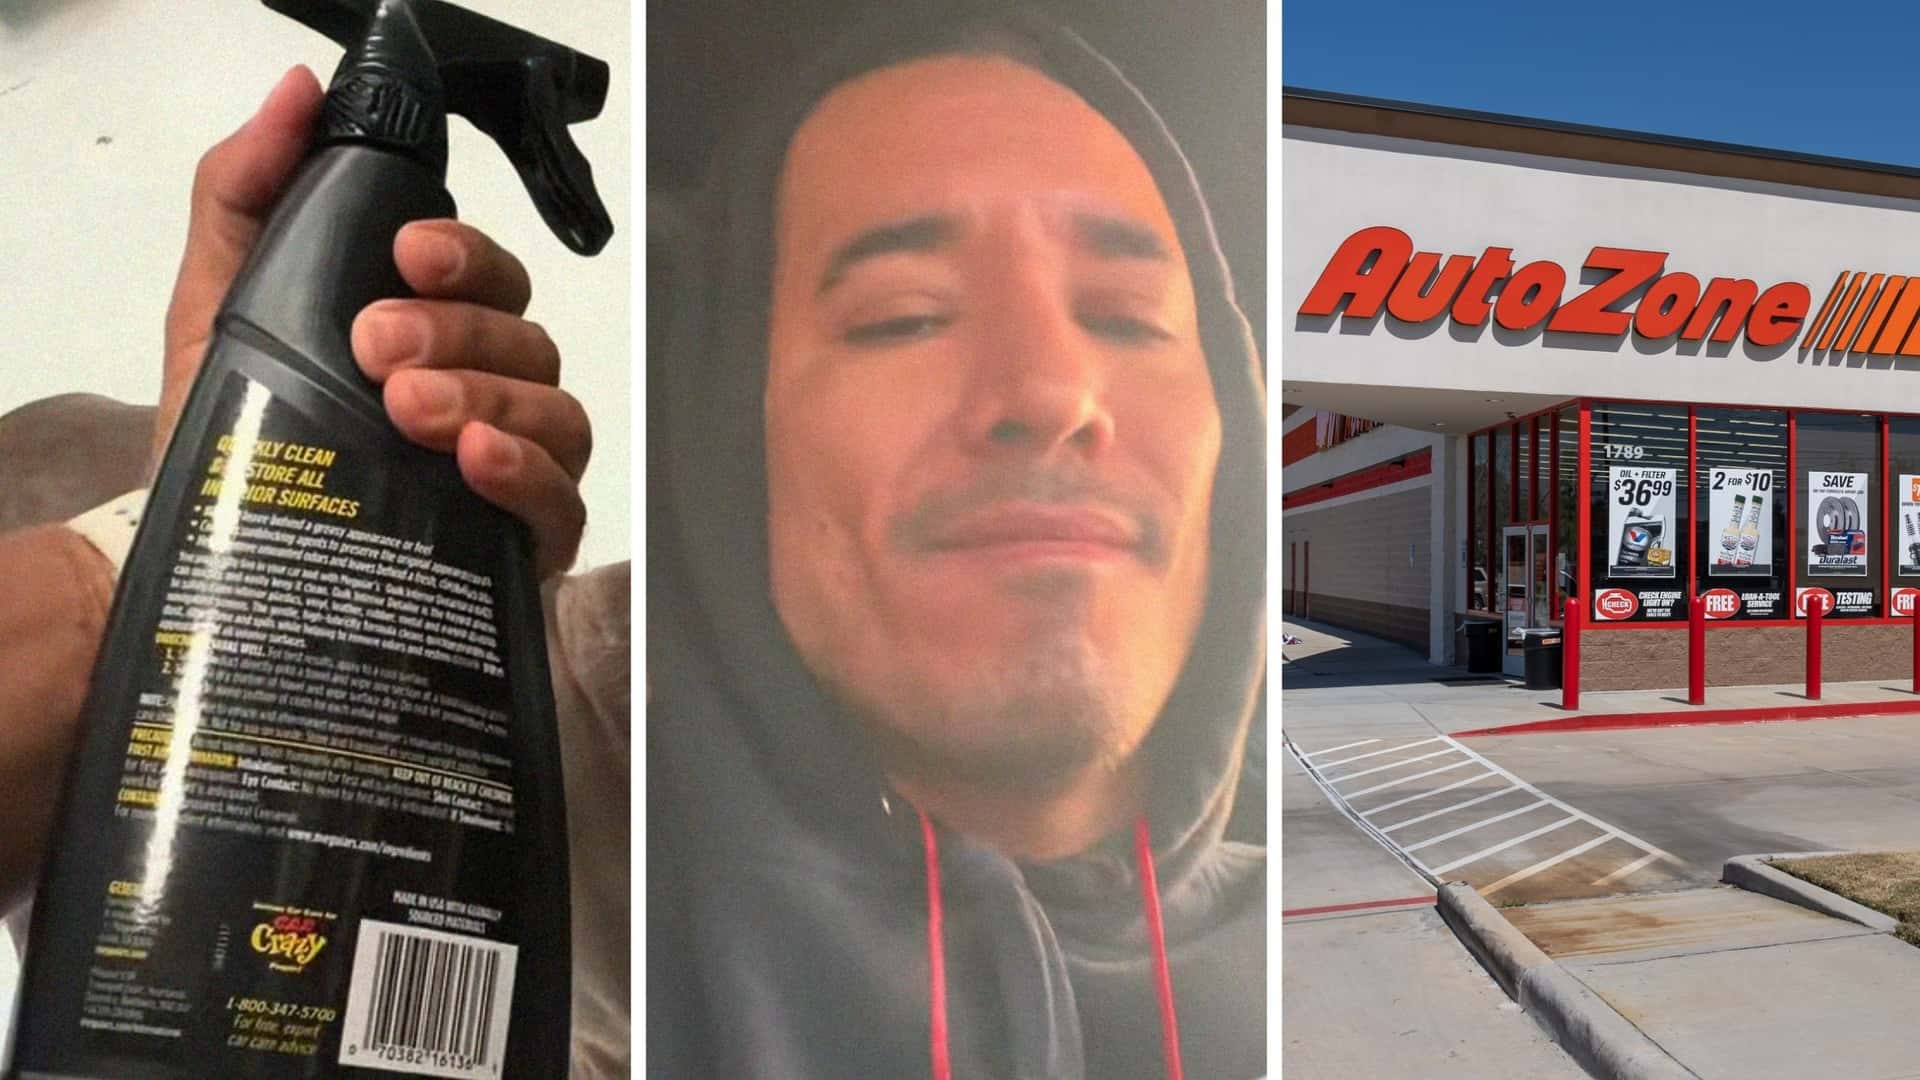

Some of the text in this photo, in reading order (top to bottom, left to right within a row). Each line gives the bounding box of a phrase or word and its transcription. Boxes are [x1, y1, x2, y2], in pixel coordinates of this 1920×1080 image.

[1299, 225, 1812, 347] AutoZone
[284, 444, 337, 467] CLEAN
[1604, 445, 1644, 459] 1789
[222, 459, 299, 484] STORE
[297, 469, 326, 489] ALL
[1620, 470, 1632, 478] OIL
[1641, 471, 1666, 479] FILTER
[1712, 472, 1771, 491] 2 FOR $10
[1823, 475, 1855, 488] SAVE
[278, 489, 361, 518] SURFACES
[1819, 554, 1857, 564] Duralast
[1706, 595, 1735, 612] FREE
[1836, 592, 1873, 605] TESTING
[393, 890, 417, 907] MADE
[418, 894, 428, 906] IN
[428, 897, 445, 910] USA
[251, 923, 327, 965] Crazy
[226, 996, 336, 1021] 1-800-347-5700
[227, 1034, 248, 1048] car
[378, 1044, 425, 1065] 70382
[433, 1052, 474, 1071] 16136
